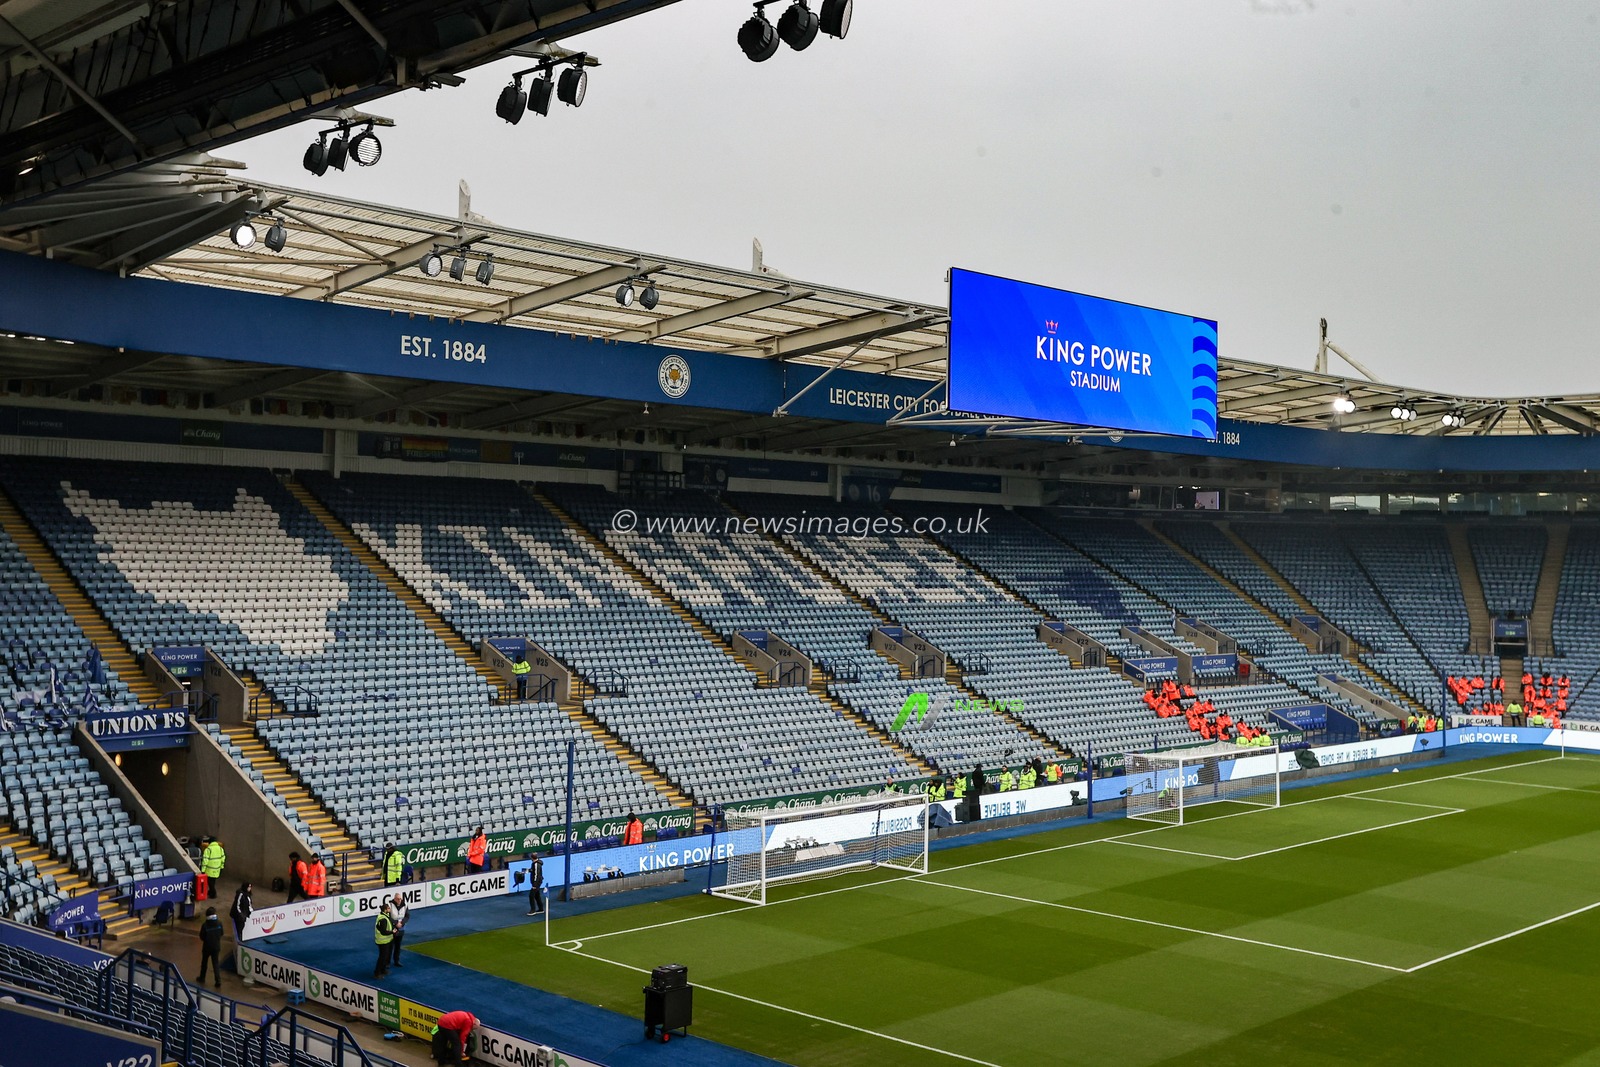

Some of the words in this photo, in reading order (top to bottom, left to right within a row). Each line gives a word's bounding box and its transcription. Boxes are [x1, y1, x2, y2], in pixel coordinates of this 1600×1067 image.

[401, 335, 437, 358] EST.
[443, 340, 486, 363] 1884
[1036, 335, 1085, 366] KING
[1091, 344, 1152, 376] POWER
[1070, 370, 1121, 393] STADIUM
[829, 387, 890, 410] LEICESTER
[893, 394, 920, 413] CITY
[195, 428, 221, 440] Chang
[1223, 431, 1240, 445] 1884
[745, 650, 758, 658] V24
[778, 649, 792, 657] V24
[492, 658, 505, 668] V25
[536, 657, 549, 667] V25
[1297, 709, 1311, 717] POWER
[92, 714, 157, 736] UNION
[162, 711, 186, 729] FS
[1460, 733, 1475, 743] KING
[1476, 732, 1518, 744] POWER
[659, 815, 692, 829] Chang
[541, 830, 579, 845] Chag
[484, 838, 516, 854] hang
[406, 847, 449, 864] Chang
[639, 851, 679, 872] KING
[683, 843, 735, 865] POWER
[134, 886, 159, 899] KING
[161, 881, 193, 895] POWER
[449, 876, 506, 897] BC.GAME
[359, 889, 422, 912] BC.GME
[62, 905, 85, 921] POWER
[252, 913, 286, 925] THAILAND
[293, 905, 326, 917] THAILAND
[254, 958, 301, 988] BC.GAME
[323, 981, 375, 1014] BC.GAME
